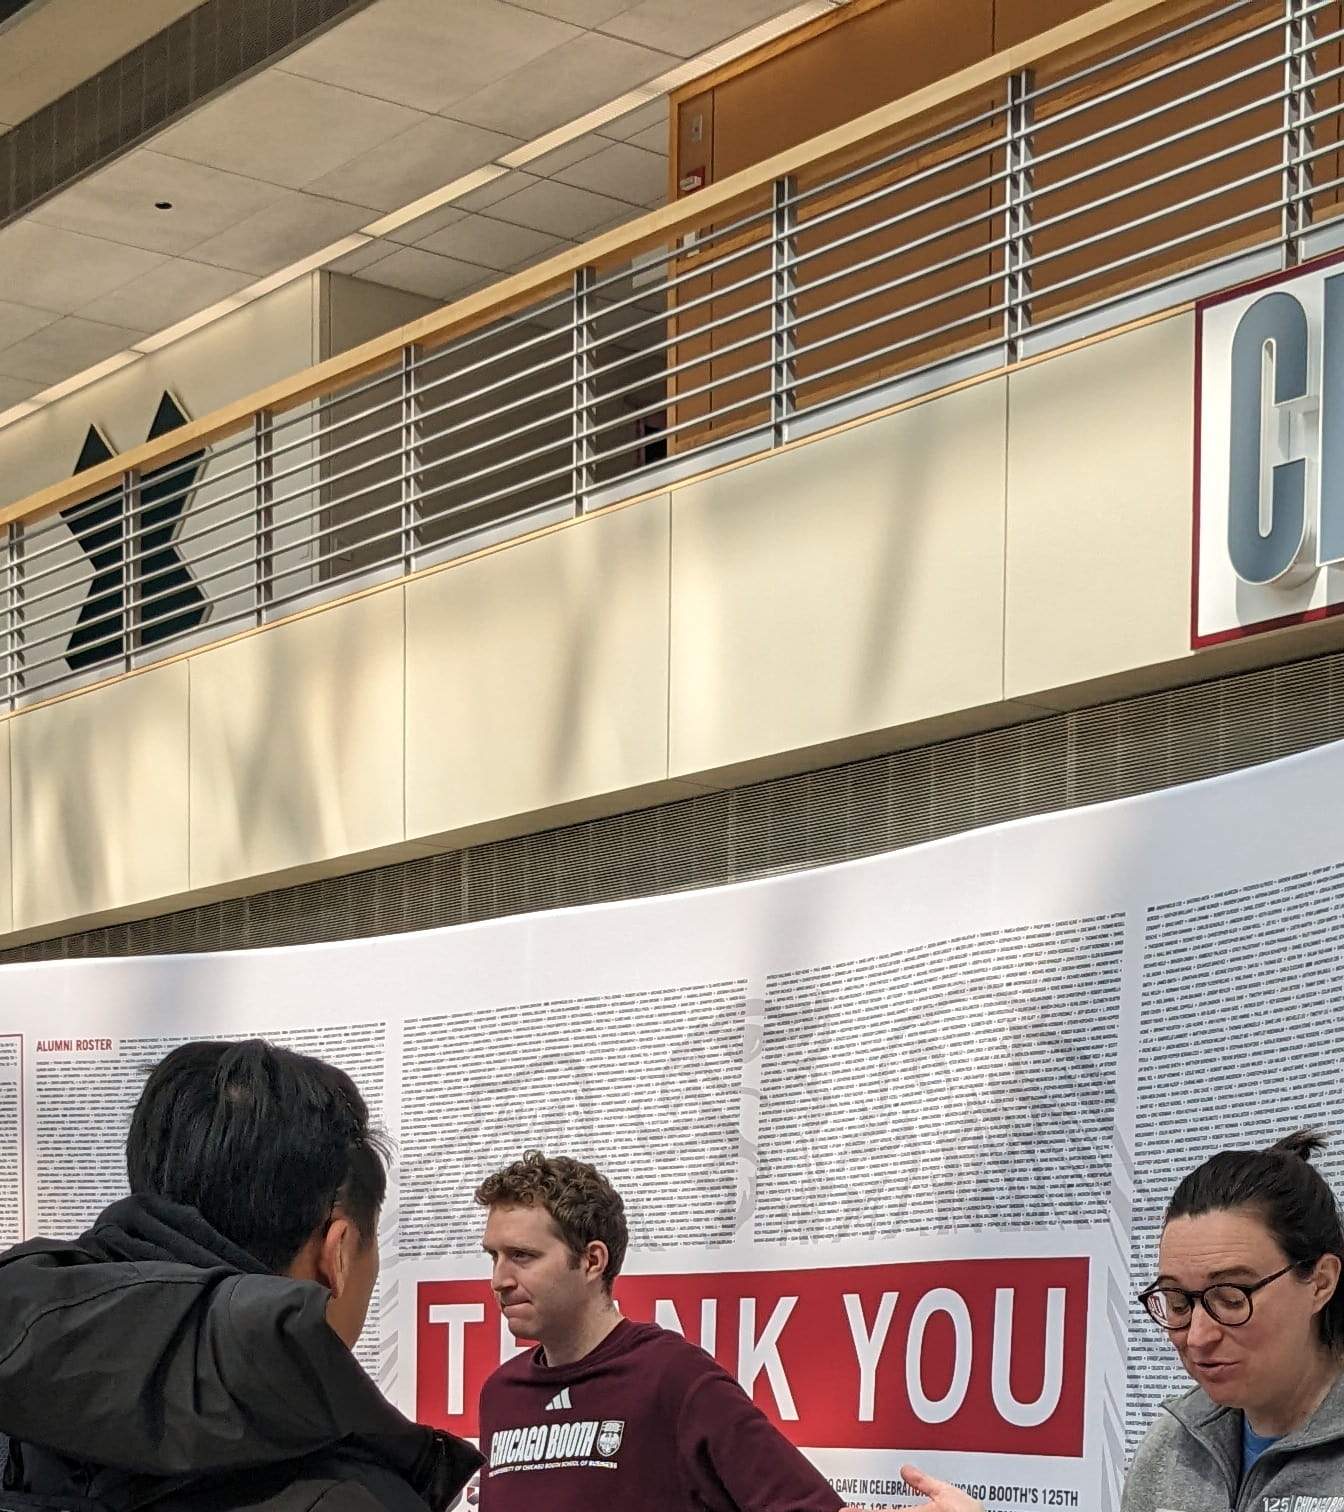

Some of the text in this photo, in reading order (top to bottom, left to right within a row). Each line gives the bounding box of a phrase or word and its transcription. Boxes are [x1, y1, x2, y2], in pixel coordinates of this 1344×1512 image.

[36, 1038, 113, 1053] ALUMNI ROSTER
[844, 1286, 1068, 1428] YOU
[489, 1421, 599, 1469] CHICAGO BOOTH
[836, 1478, 858, 1494] GAVE
[859, 1479, 868, 1494] IN
[988, 1485, 1039, 1503] BOOTH'S
[1041, 1488, 1079, 1507] 125TH
[1262, 1496, 1290, 1512] 125
